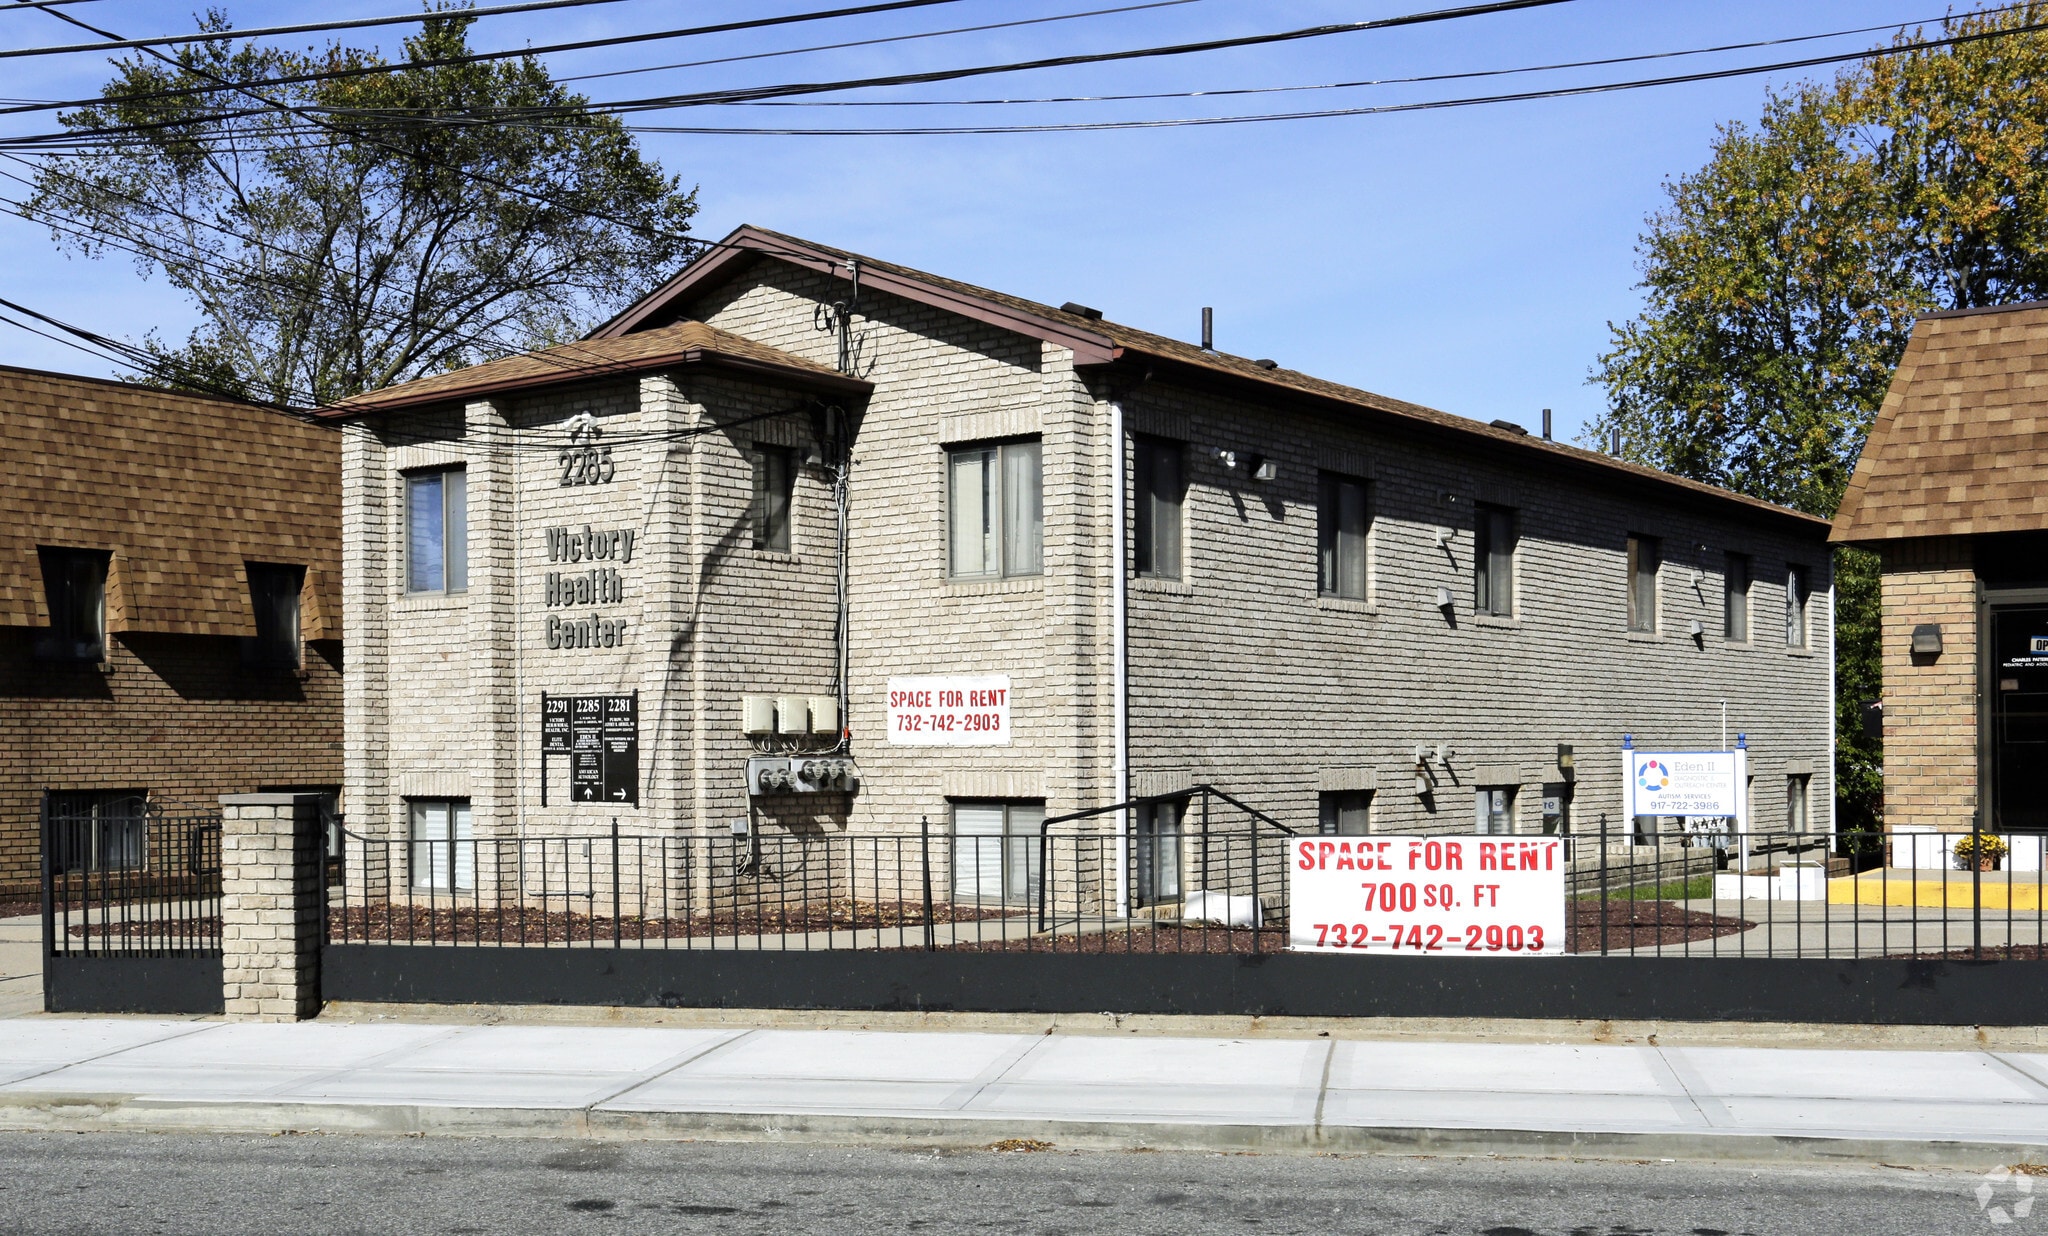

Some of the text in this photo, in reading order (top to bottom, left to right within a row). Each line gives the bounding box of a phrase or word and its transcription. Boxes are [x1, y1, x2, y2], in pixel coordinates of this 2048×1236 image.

[558, 447, 614, 487] 2285
[545, 525, 635, 563] Victory
[545, 567, 623, 607] Health
[545, 613, 627, 649] Center
[546, 700, 568, 713] 2291
[576, 699, 600, 713] 2285
[608, 699, 630, 712] 2281
[890, 689, 1006, 708] SPACE FOR RENT
[897, 714, 1000, 731] 732-742-2903
[1674, 761, 1715, 771] Eden II
[1650, 801, 1720, 810] 917-722-3986
[1298, 841, 1558, 871] SPACE FOR RENT
[1361, 882, 1500, 912] 700 SQ. FT
[1313, 923, 1545, 951] 732-742-2903
